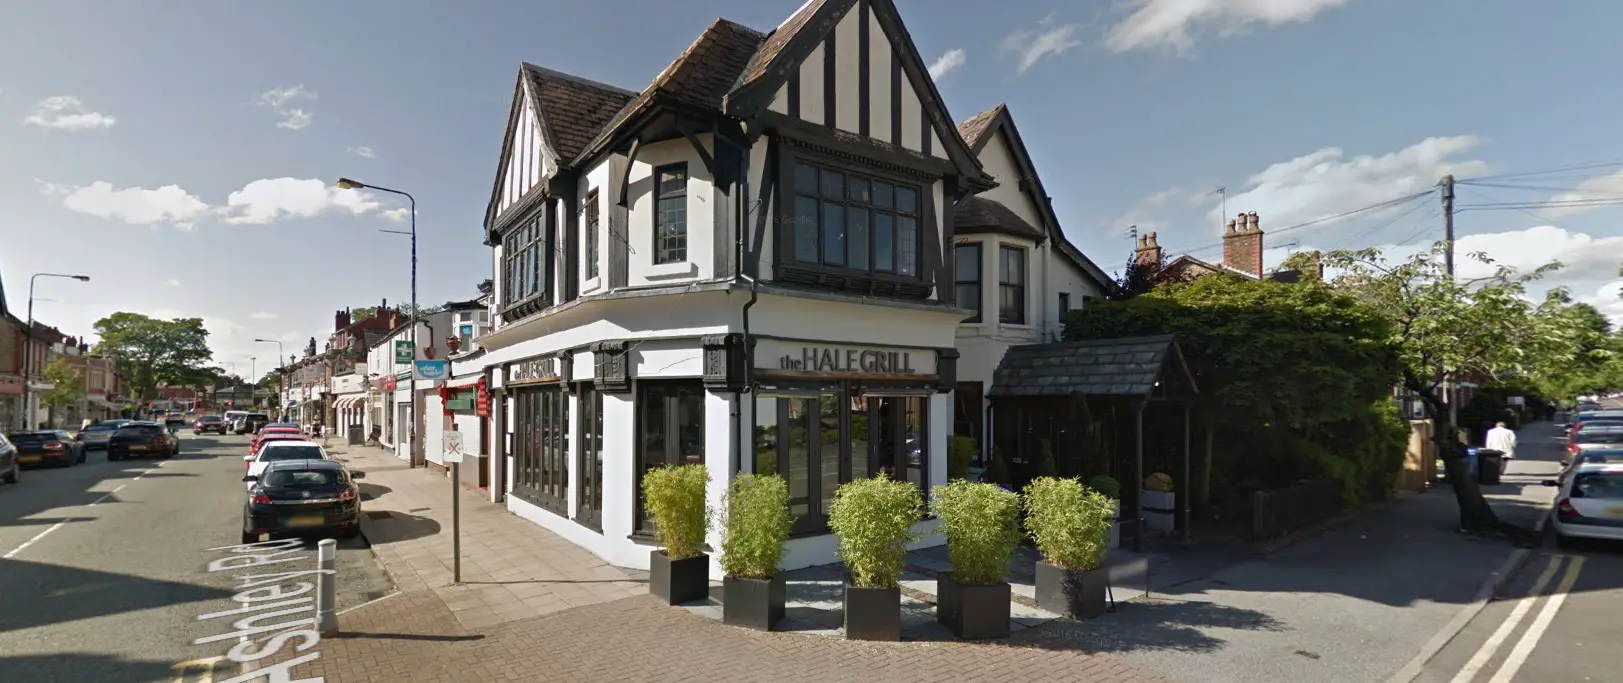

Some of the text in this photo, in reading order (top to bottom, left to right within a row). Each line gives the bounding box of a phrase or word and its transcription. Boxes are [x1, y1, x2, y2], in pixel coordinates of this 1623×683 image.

[780, 347, 916, 373] the HALE GRILL
